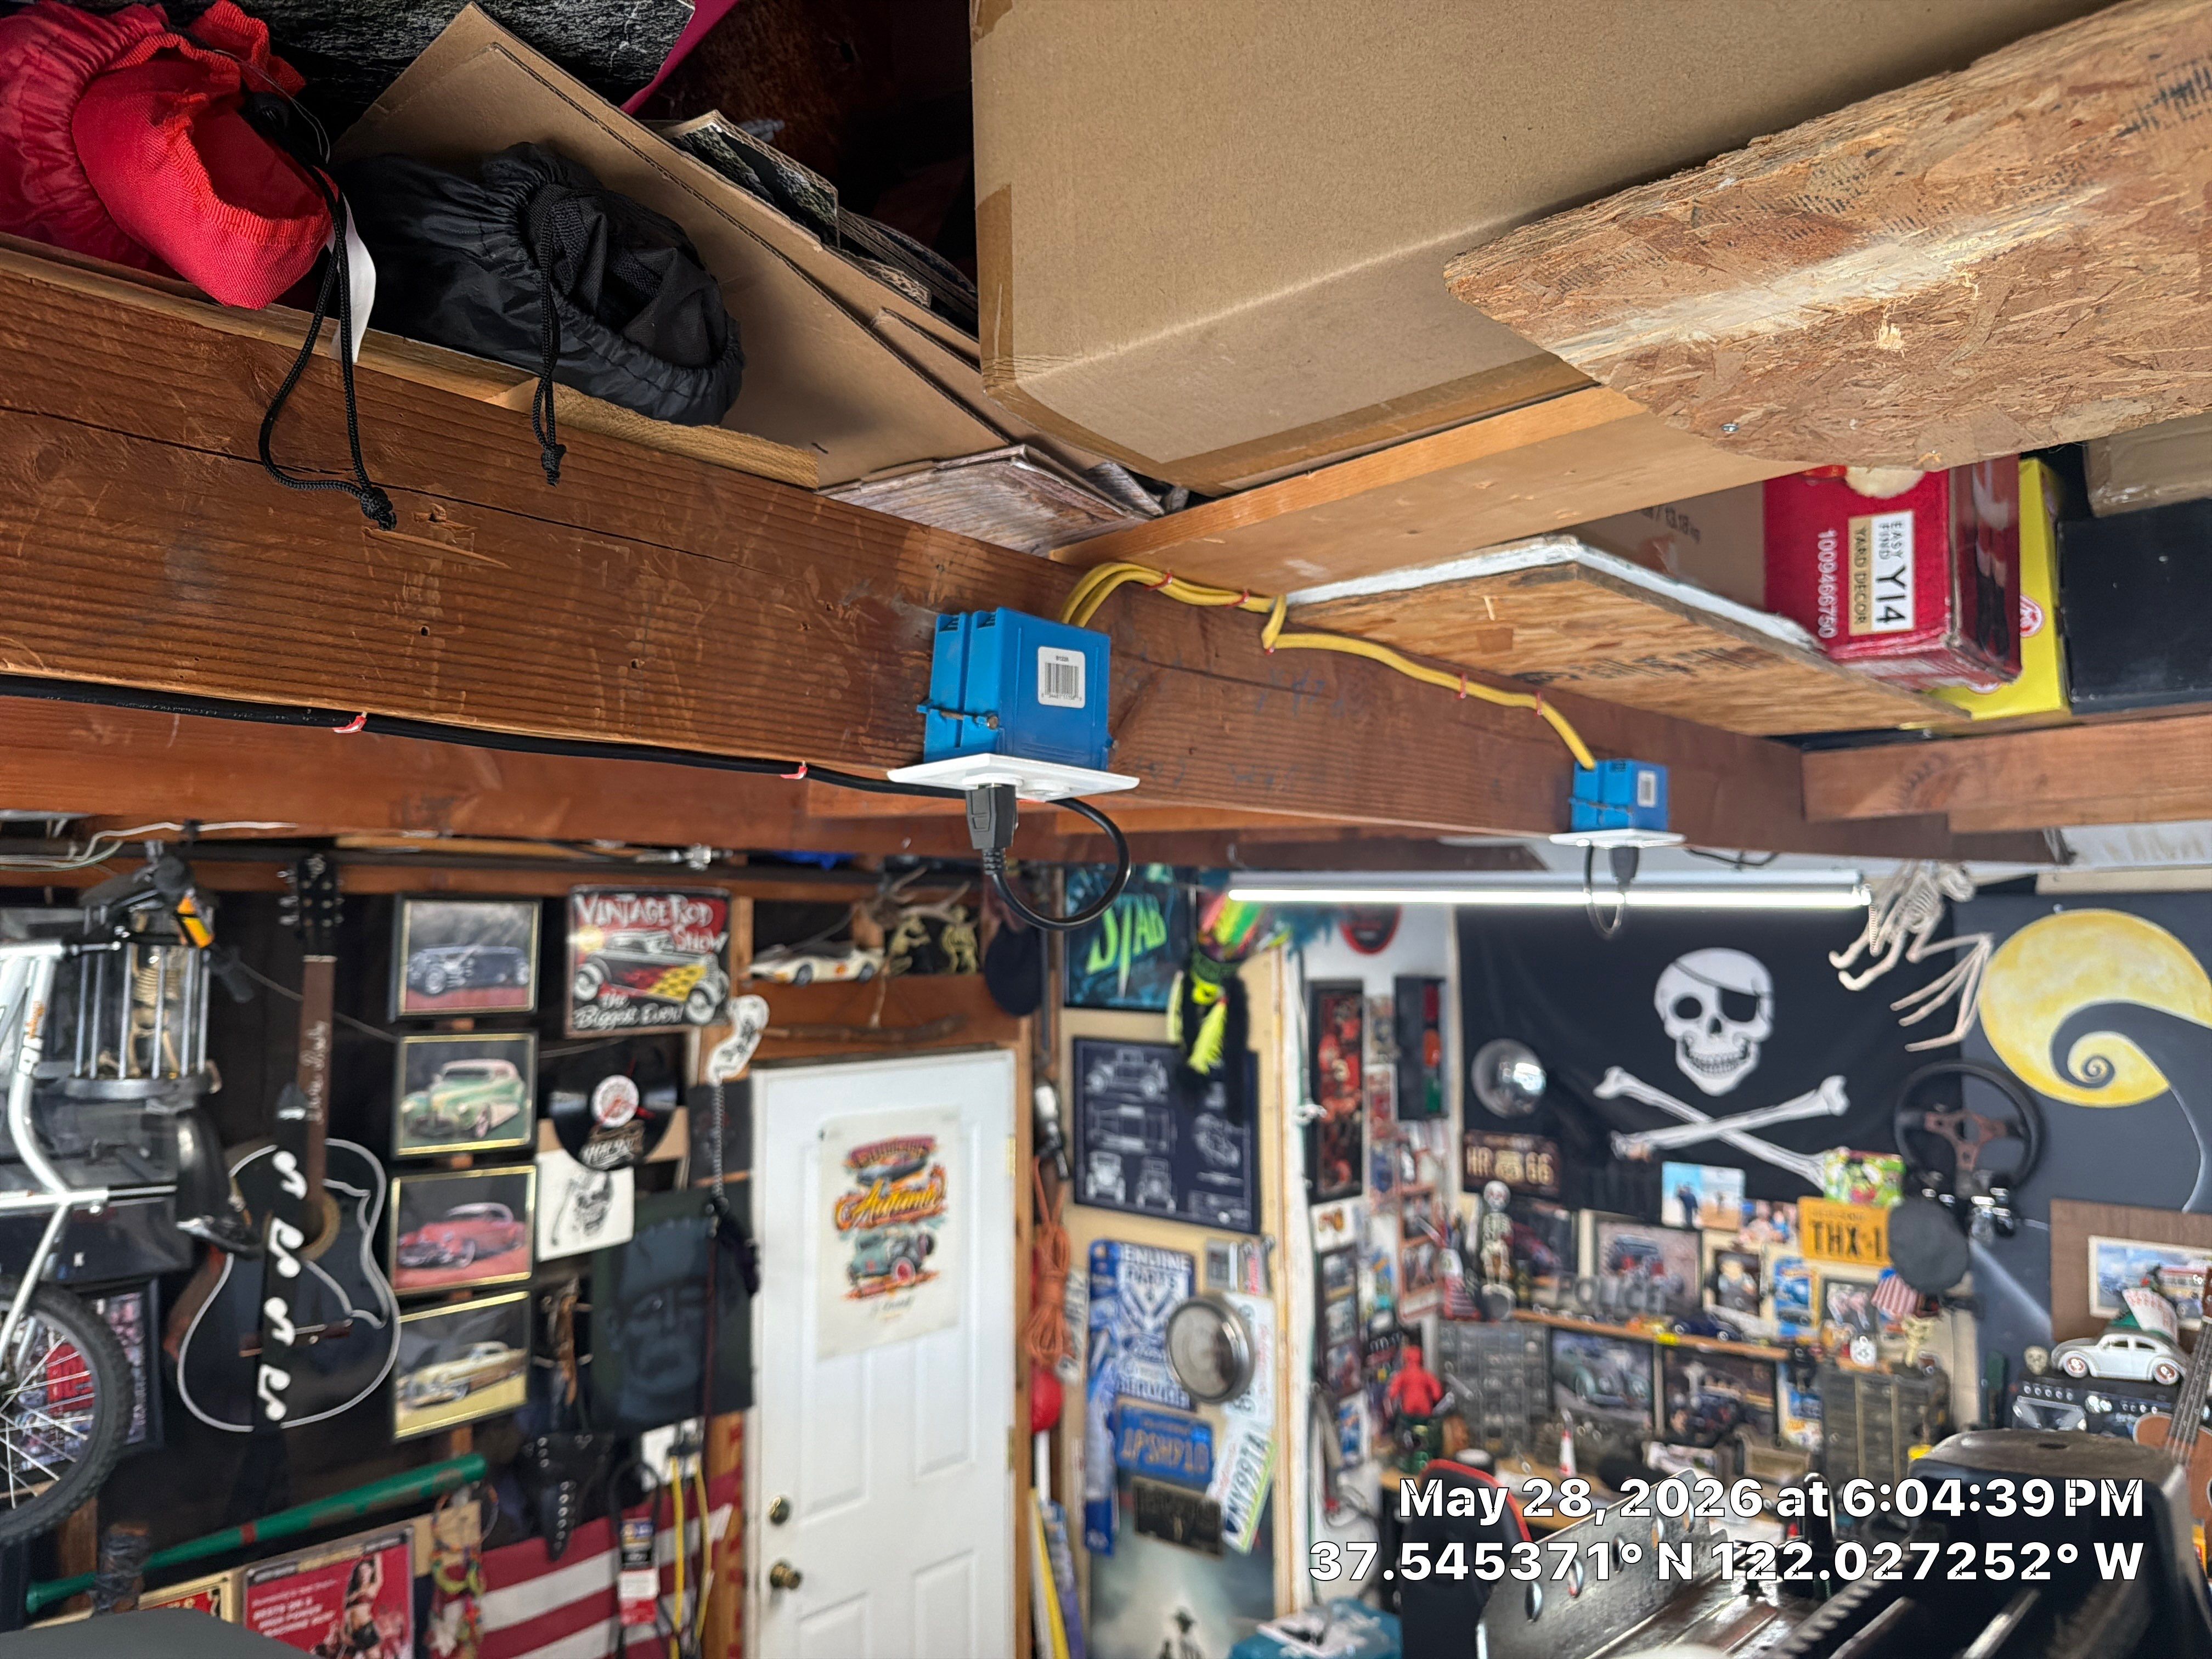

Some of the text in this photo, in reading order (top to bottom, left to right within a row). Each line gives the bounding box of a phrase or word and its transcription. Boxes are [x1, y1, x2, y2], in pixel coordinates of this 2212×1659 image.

[1878, 523, 1891, 560] FIND
[1891, 521, 1905, 558] EASY
[1817, 529, 1838, 639] 1009466750
[1854, 526, 1867, 625] YARD DECOR
